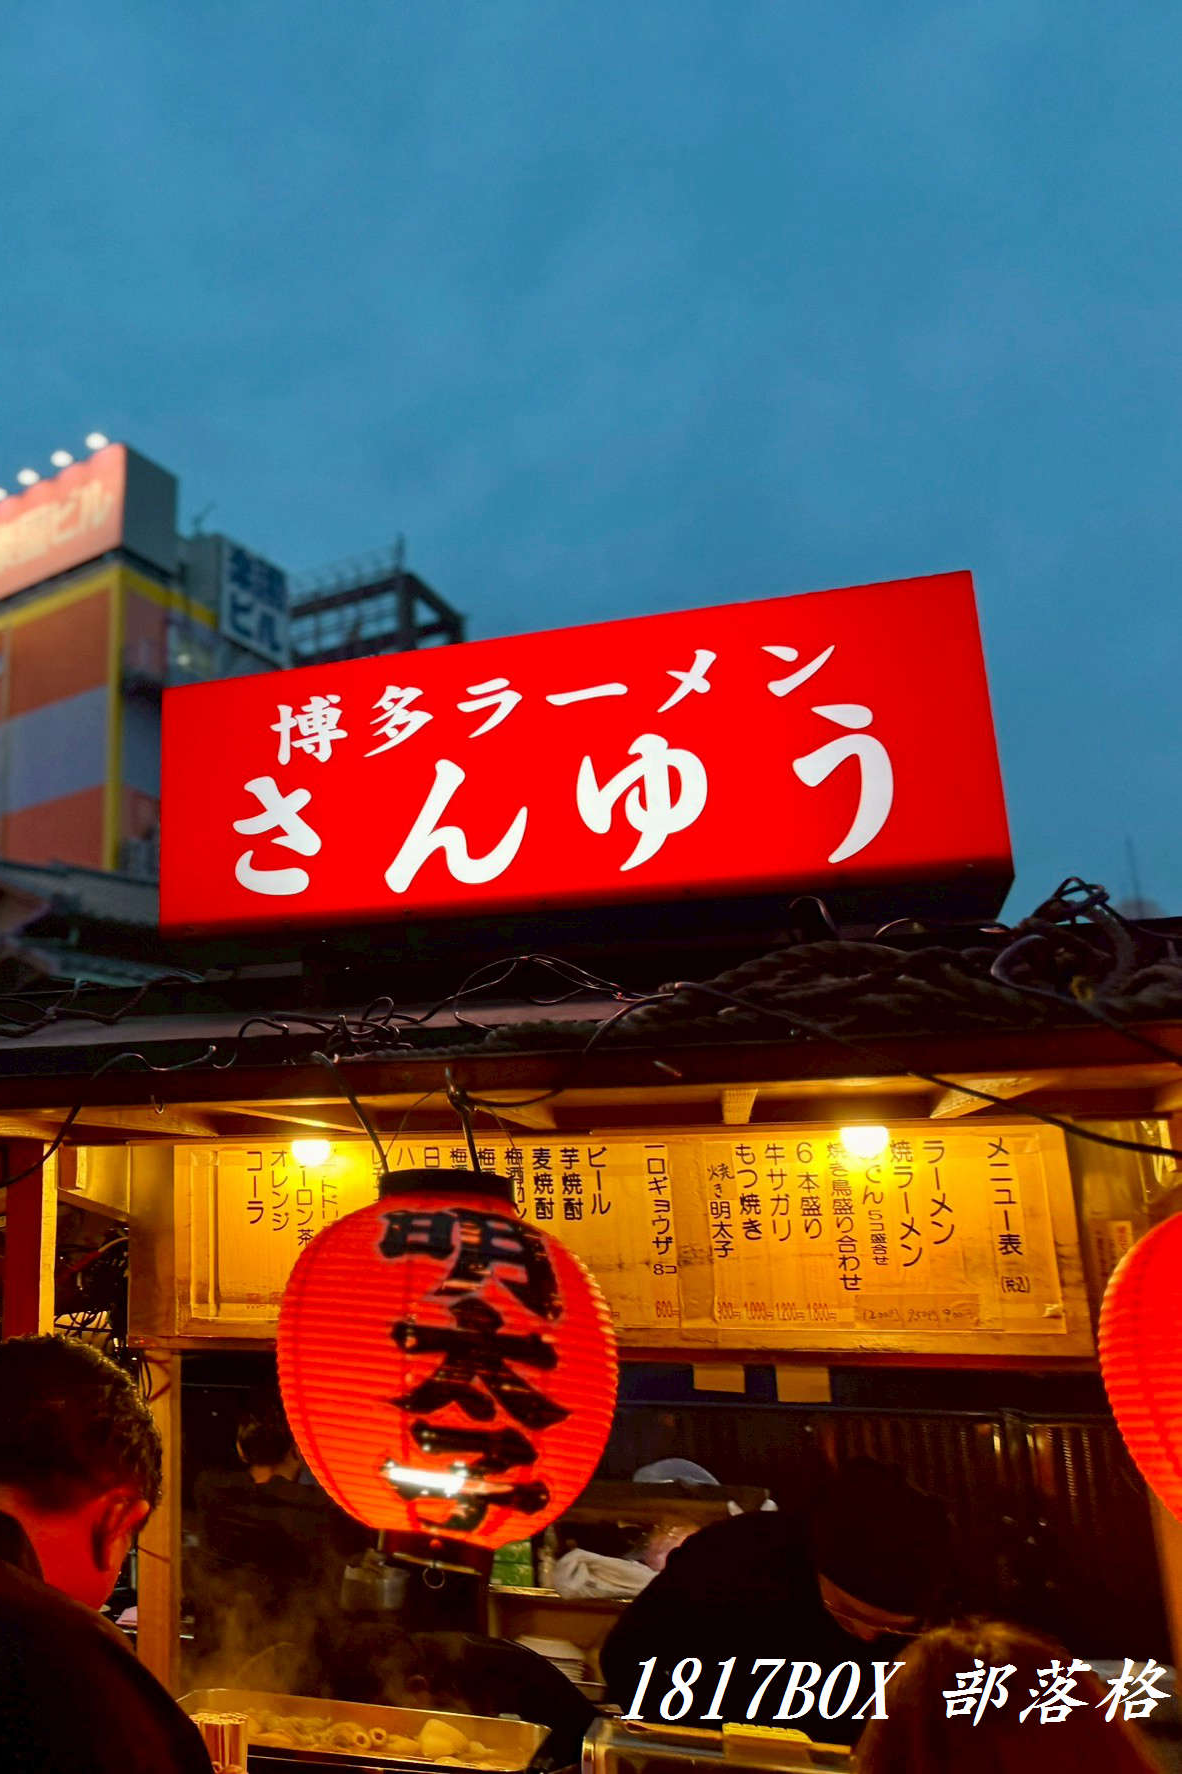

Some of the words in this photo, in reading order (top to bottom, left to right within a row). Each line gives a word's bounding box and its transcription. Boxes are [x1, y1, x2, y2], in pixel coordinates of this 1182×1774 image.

[270, 644, 836, 766] 博多ラーメン
[232, 703, 895, 896] さんゆう
[246, 1151, 264, 1224] コーラ
[271, 1150, 289, 1231] オレンジ
[296, 1164, 314, 1246] ーロン茶
[532, 1147, 554, 1220] 麦焼酎
[560, 1147, 584, 1221] 芋焼酎
[587, 1146, 611, 1215] ビール
[707, 1162, 735, 1258] 焼き明太子
[735, 1143, 763, 1240] もつ焼き
[764, 1143, 792, 1242] 牛サガリ
[796, 1142, 823, 1239] 6本盛り
[890, 1139, 923, 1267] 焼ラーメン
[923, 1139, 955, 1245] ラーメン
[987, 1136, 1023, 1256] メニュー表
[379, 1208, 571, 1531] 明太子
